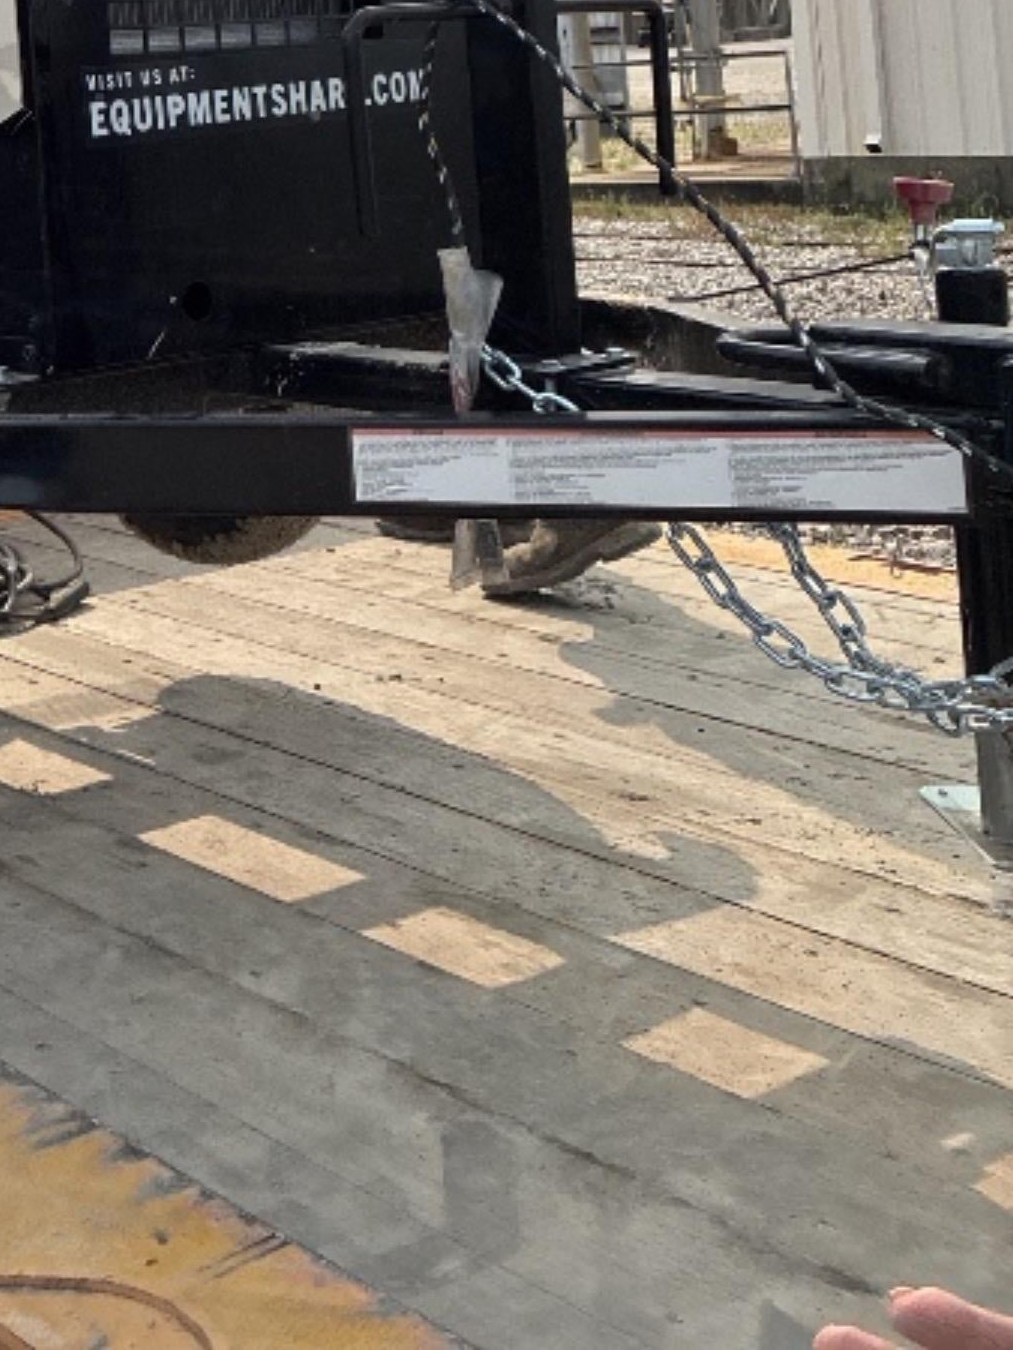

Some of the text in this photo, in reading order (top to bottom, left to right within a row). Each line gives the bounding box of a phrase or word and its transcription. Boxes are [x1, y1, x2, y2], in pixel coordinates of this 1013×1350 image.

[85, 65, 195, 91] VISIT US AT:
[89, 69, 428, 137] EQUIPMENTSHAR.COM
